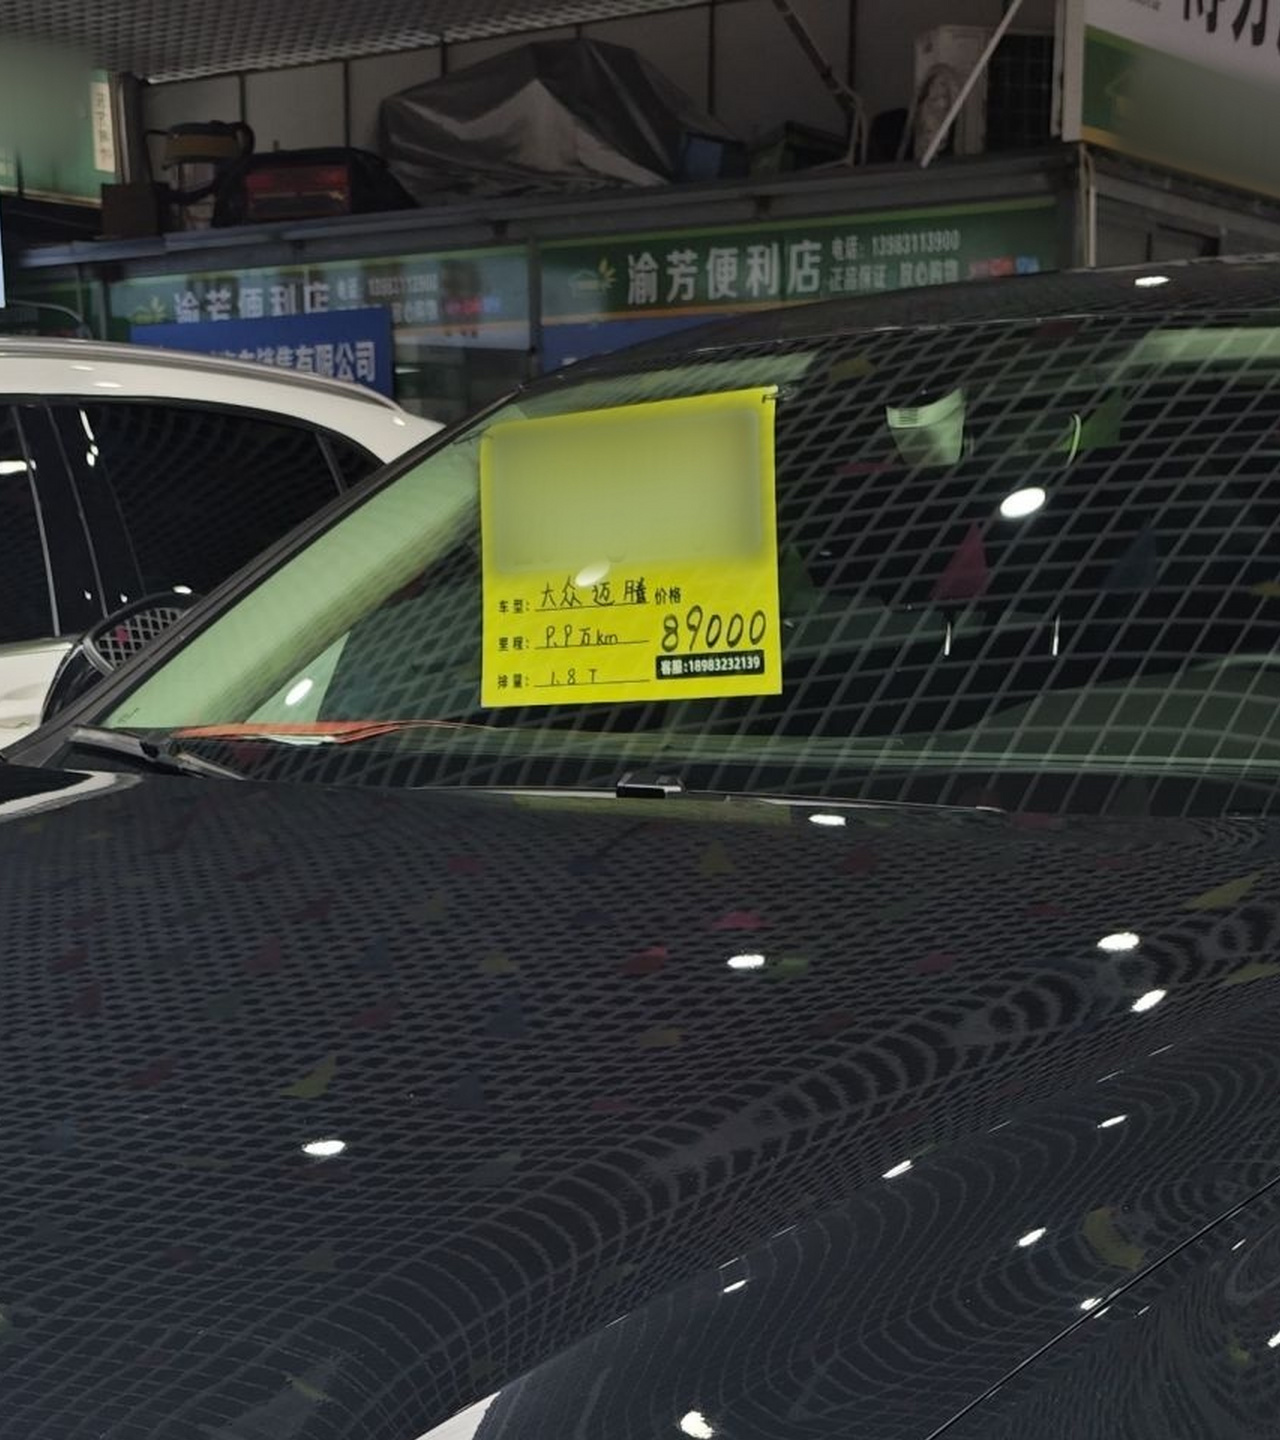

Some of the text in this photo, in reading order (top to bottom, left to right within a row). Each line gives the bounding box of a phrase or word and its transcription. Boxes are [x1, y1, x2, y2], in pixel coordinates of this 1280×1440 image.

[627, 240, 821, 304] 渝芳便利店
[654, 587, 682, 605] 价格
[661, 605, 766, 652] 89000
